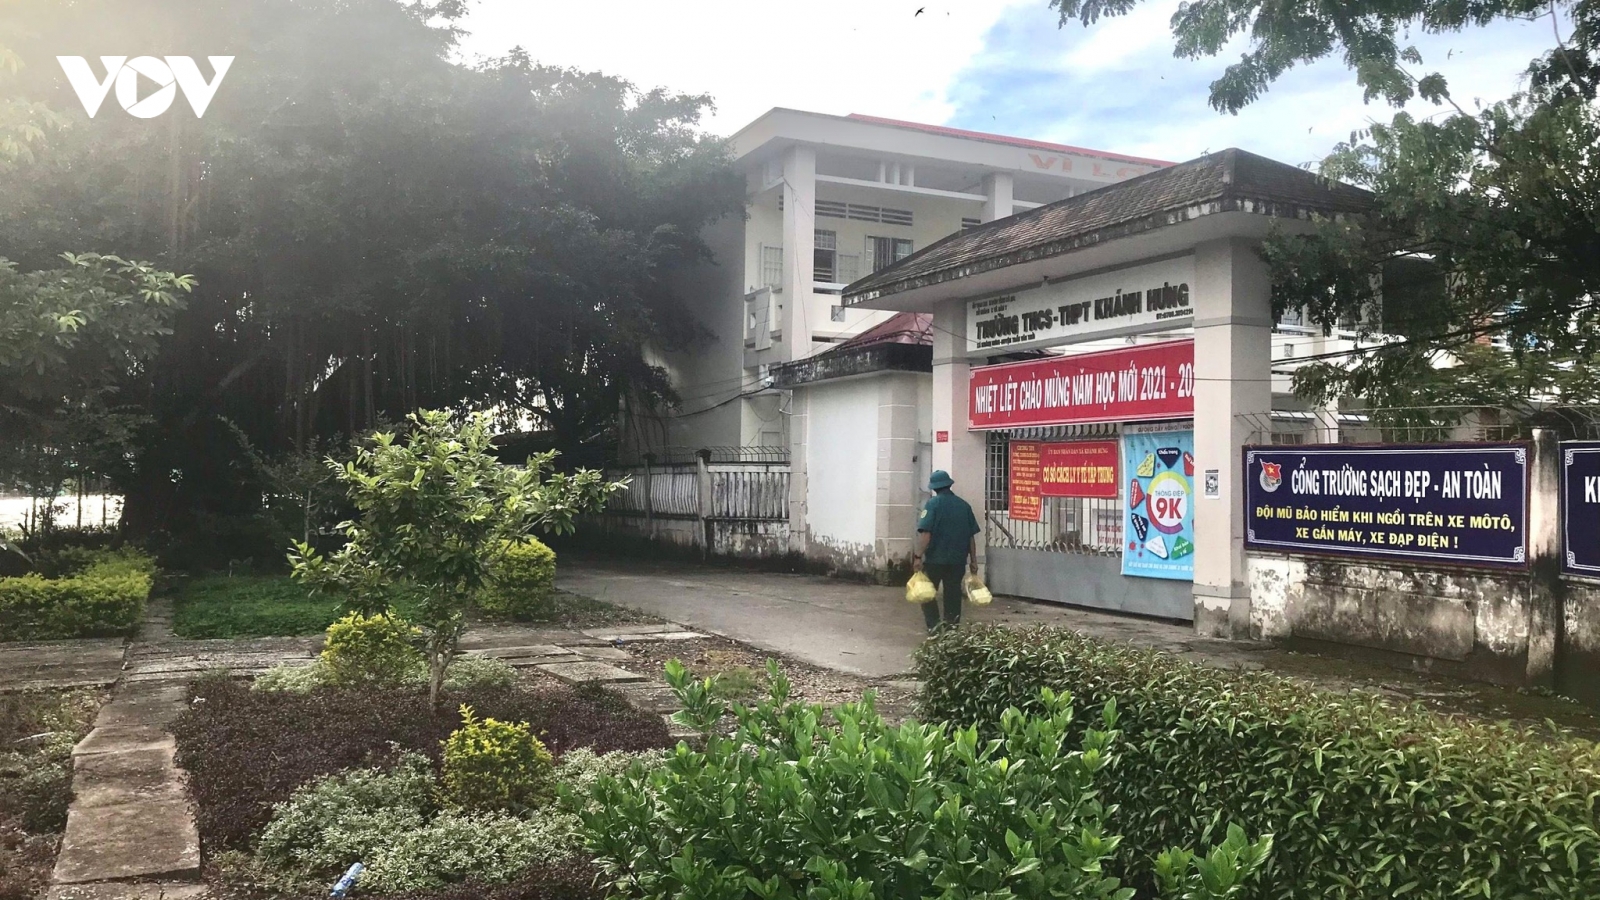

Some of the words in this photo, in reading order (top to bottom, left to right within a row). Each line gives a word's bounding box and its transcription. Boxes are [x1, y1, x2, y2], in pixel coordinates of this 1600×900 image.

[976, 313, 1019, 340] TRƯỜNG
[1094, 288, 1142, 320] KHÁNH
[1146, 282, 1189, 312] HƯNG
[975, 377, 998, 419] NHIỆT
[1000, 375, 1018, 417] LIỆT
[1020, 372, 1042, 410] CHÀO
[1044, 369, 1070, 408] MỪNG
[1072, 368, 1093, 406] NĂM
[1095, 371, 1115, 410] HỌC
[1118, 360, 1138, 402] MỚI
[1140, 365, 1166, 400] 2021
[1057, 462, 1069, 483] CÁCH
[1070, 467, 1077, 483] LY
[1077, 467, 1081, 483] Y
[1081, 460, 1088, 483] TẾ
[1088, 462, 1096, 488] TẬP
[1097, 467, 1114, 483] TRUNG
[1291, 457, 1320, 495] CỔNG
[1322, 463, 1367, 496] TRƯỜNG
[1370, 470, 1400, 502] SẠCH
[1405, 470, 1430, 503] ĐẸP
[1442, 471, 1460, 498] AN
[1464, 463, 1501, 499] TOÀN
[1155, 489, 1172, 497] THÔNG
[1156, 497, 1182, 519] 9K
[1256, 504, 1274, 519] ĐỘI
[1276, 506, 1292, 519] MŨ
[1295, 505, 1317, 520] BẢO
[1321, 505, 1349, 522] HIỂM
[1353, 511, 1373, 524] KHI
[1377, 508, 1405, 525] NGỒI
[1408, 511, 1443, 527] TRÊN
[1447, 515, 1465, 528] XE
[1469, 513, 1515, 532] MÔTÔ,
[1295, 527, 1309, 538] XE
[1312, 524, 1335, 540] GẮN
[1337, 527, 1366, 545] MÁY,
[1370, 531, 1385, 544] XE
[1389, 532, 1414, 547] ĐẠP
[1417, 532, 1449, 550] ĐIỆN
[1454, 536, 1459, 549] !
